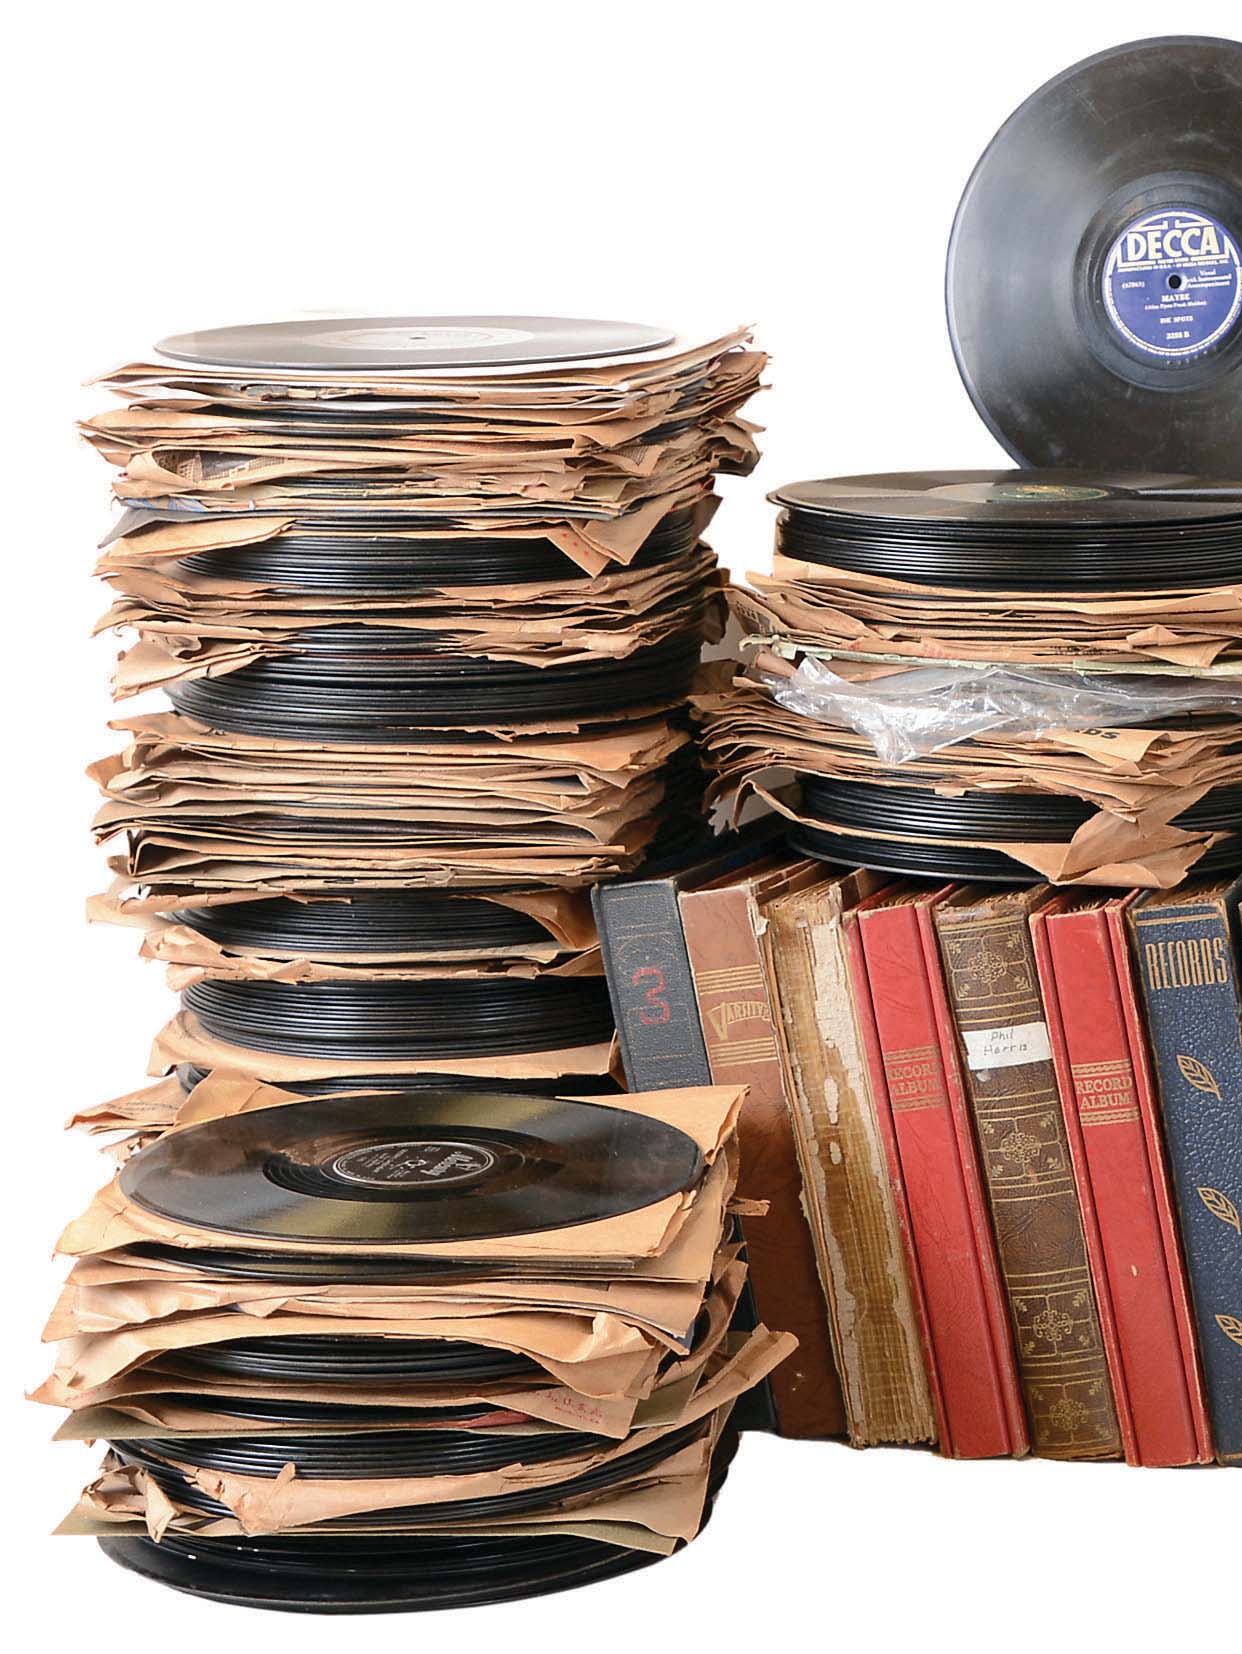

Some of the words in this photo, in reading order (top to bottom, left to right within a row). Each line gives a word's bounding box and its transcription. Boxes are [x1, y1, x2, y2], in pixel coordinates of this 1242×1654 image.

[1127, 225, 1220, 261] DECCA
[1161, 293, 1191, 302] MAYBE
[1145, 937, 1228, 990] RECORDS
[632, 967, 671, 1025] 3
[991, 1028, 1014, 1041] Phil
[1075, 1076, 1133, 1094] RECORD
[1080, 1092, 1131, 1110] ALBUM
